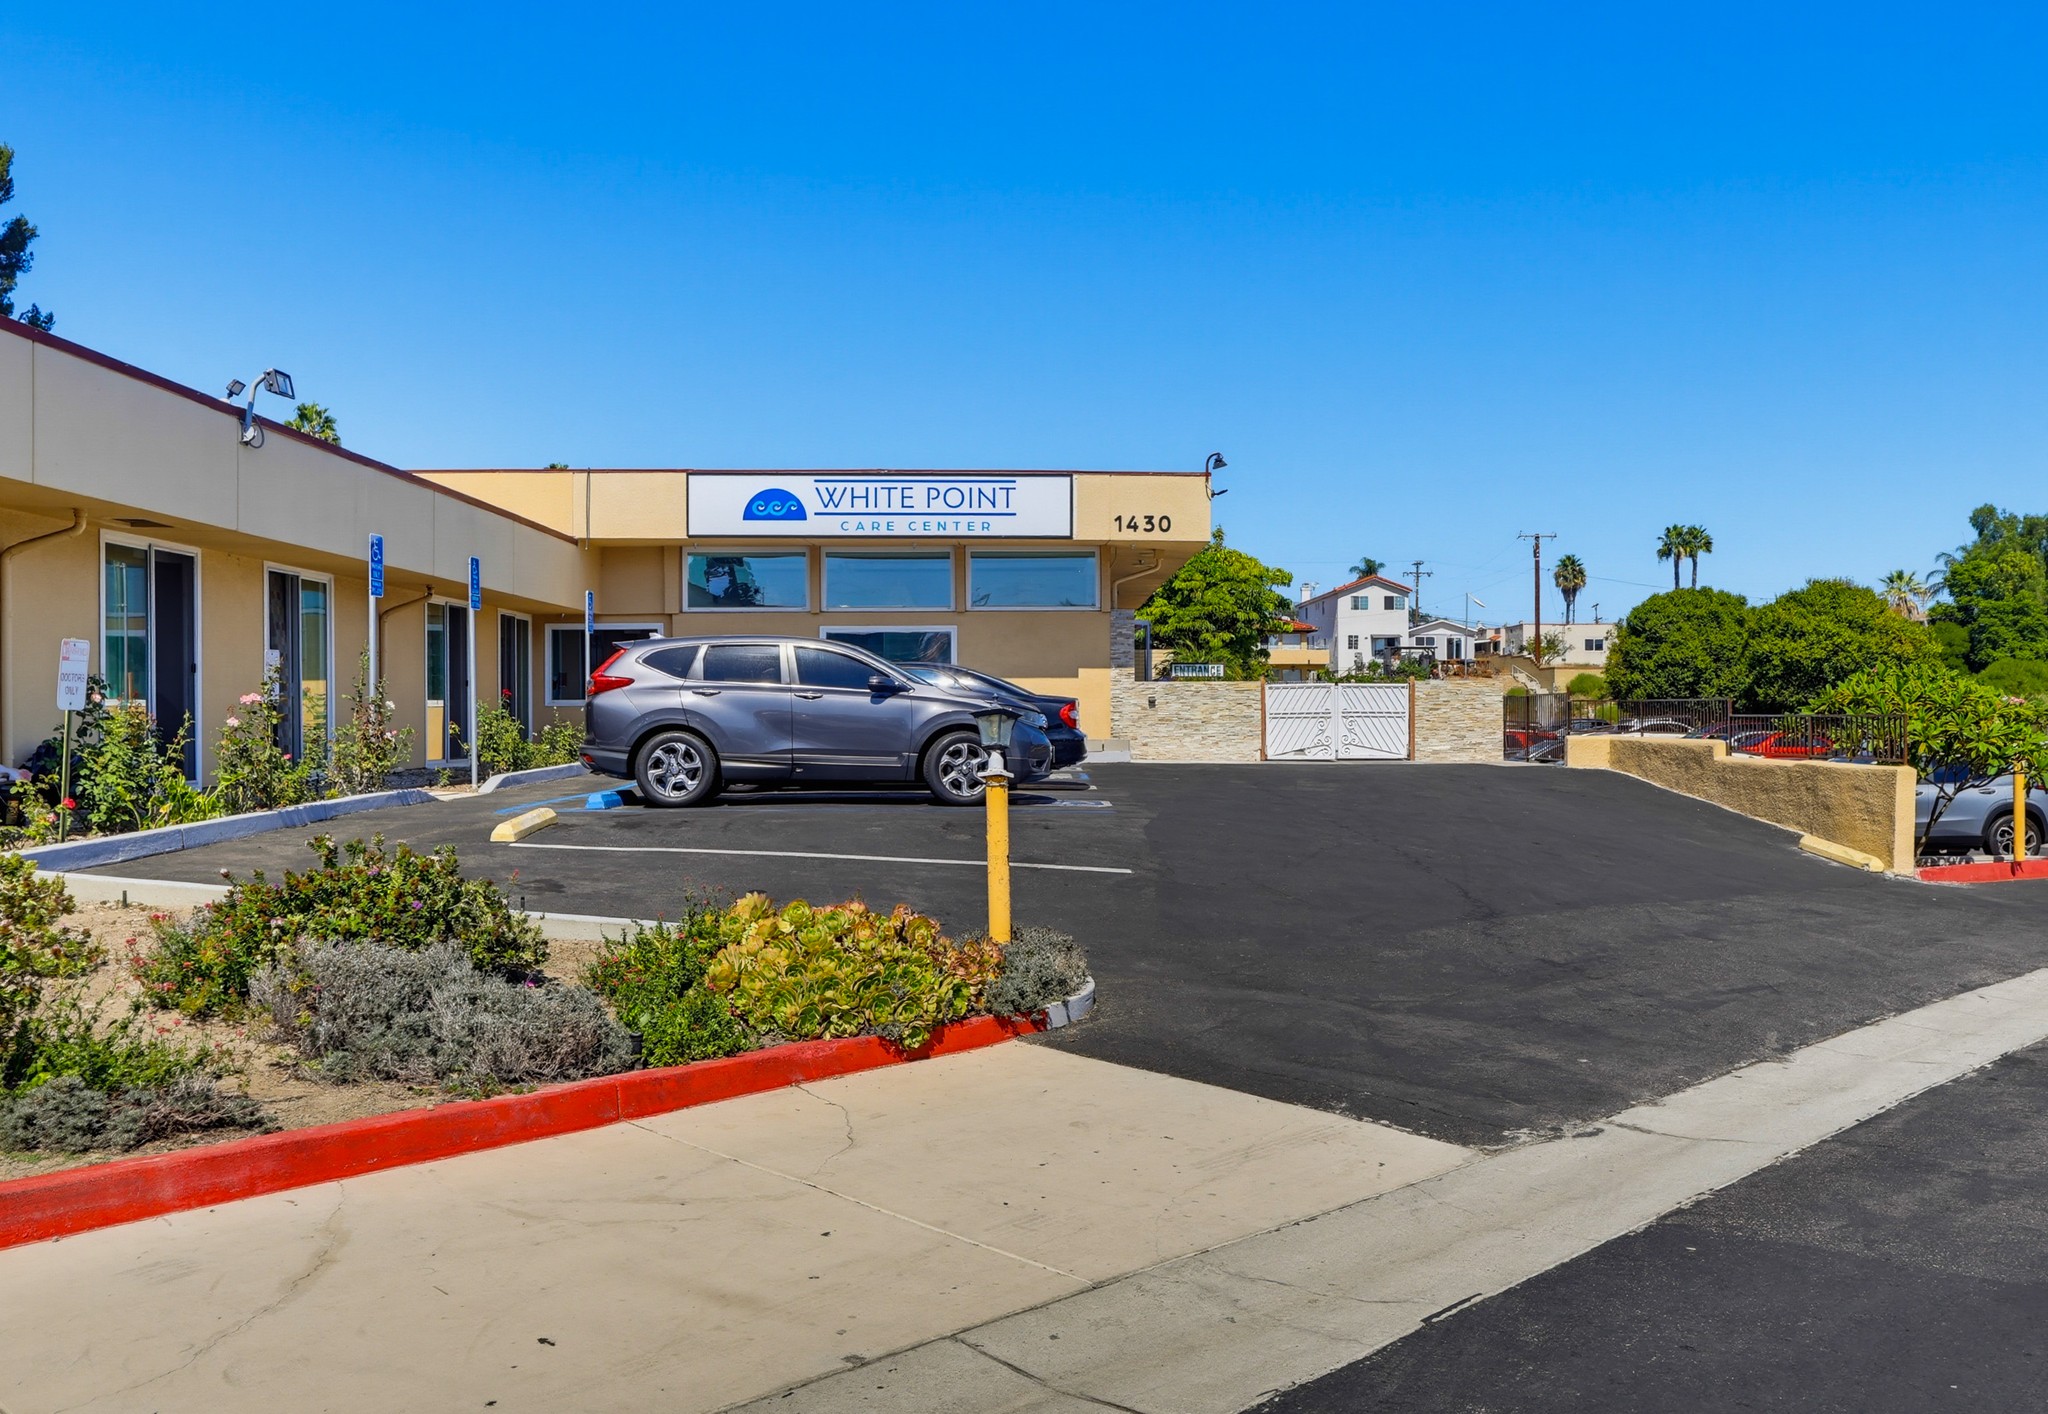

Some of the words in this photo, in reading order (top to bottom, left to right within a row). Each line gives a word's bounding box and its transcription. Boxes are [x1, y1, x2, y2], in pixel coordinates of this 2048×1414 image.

[815, 487, 915, 509] WHITE
[927, 487, 1017, 509] POINT
[840, 521, 895, 532] CARE
[908, 521, 991, 532] CENTER
[1114, 515, 1171, 533] 1430
[1173, 665, 1222, 677] ENTRANCE
